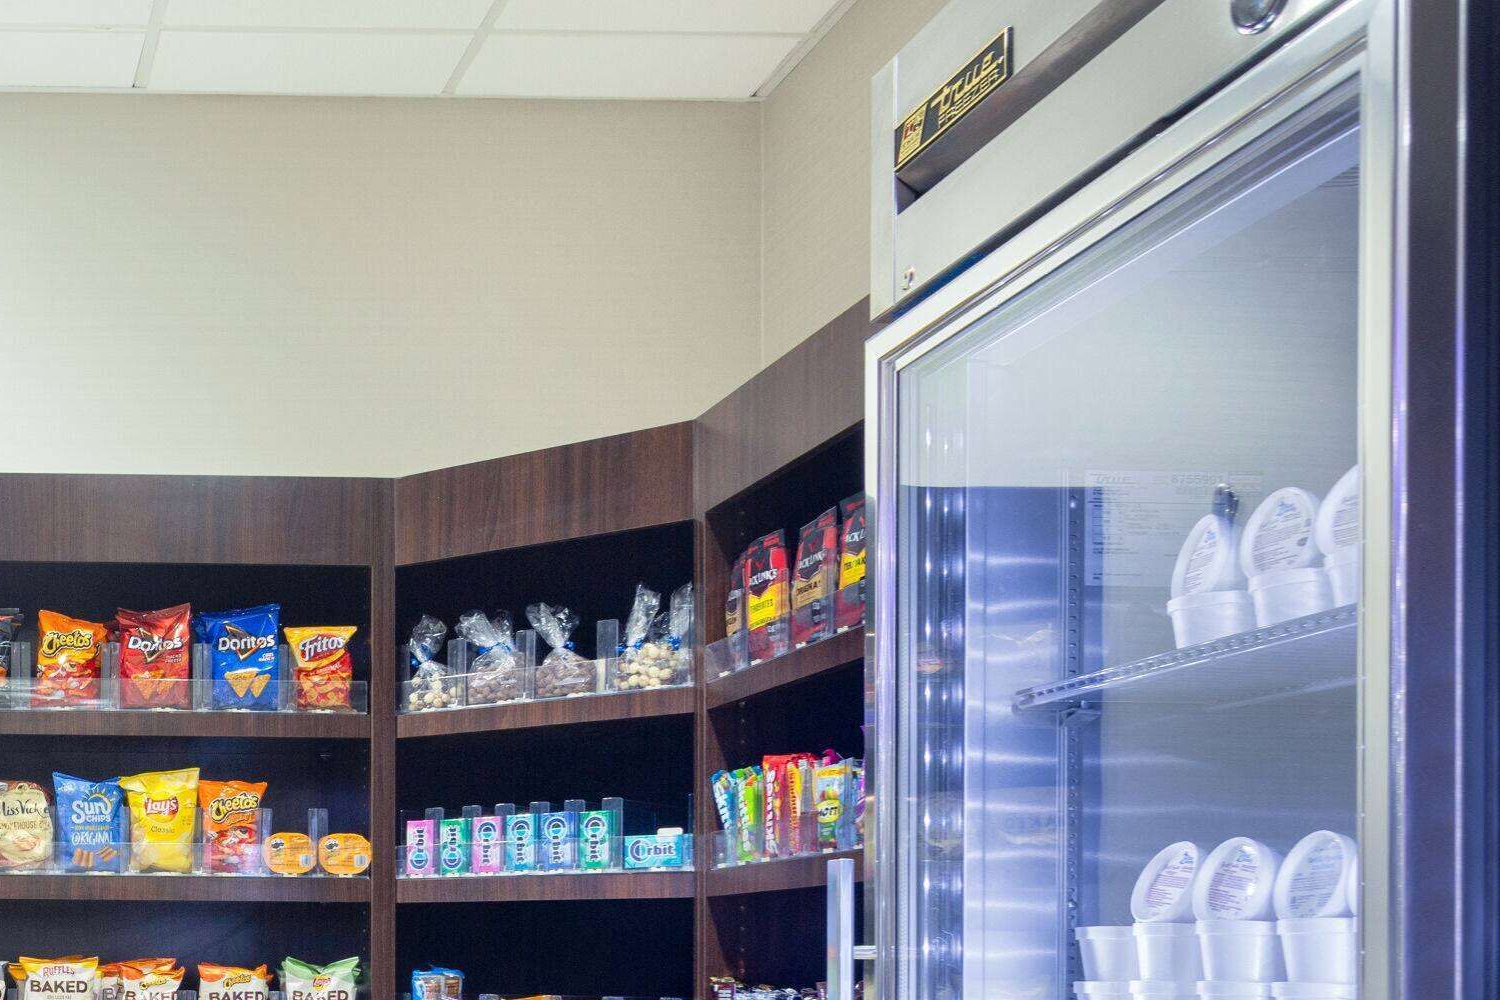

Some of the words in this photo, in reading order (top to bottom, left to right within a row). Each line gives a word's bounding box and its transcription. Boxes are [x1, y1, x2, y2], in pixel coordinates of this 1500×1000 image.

[41, 629, 93, 656] Cheetos
[128, 635, 184, 652] Doritos
[218, 634, 276, 652] Doritos
[300, 635, 346, 661] Fritos
[145, 797, 179, 816] Lay's
[210, 793, 260, 821] Cheetos
[71, 831, 114, 845] ORIGINAL
[150, 825, 175, 833] Classic
[628, 838, 675, 863] Orbit
[42, 965, 76, 977] RUFFLES
[30, 980, 88, 993] BAKED
